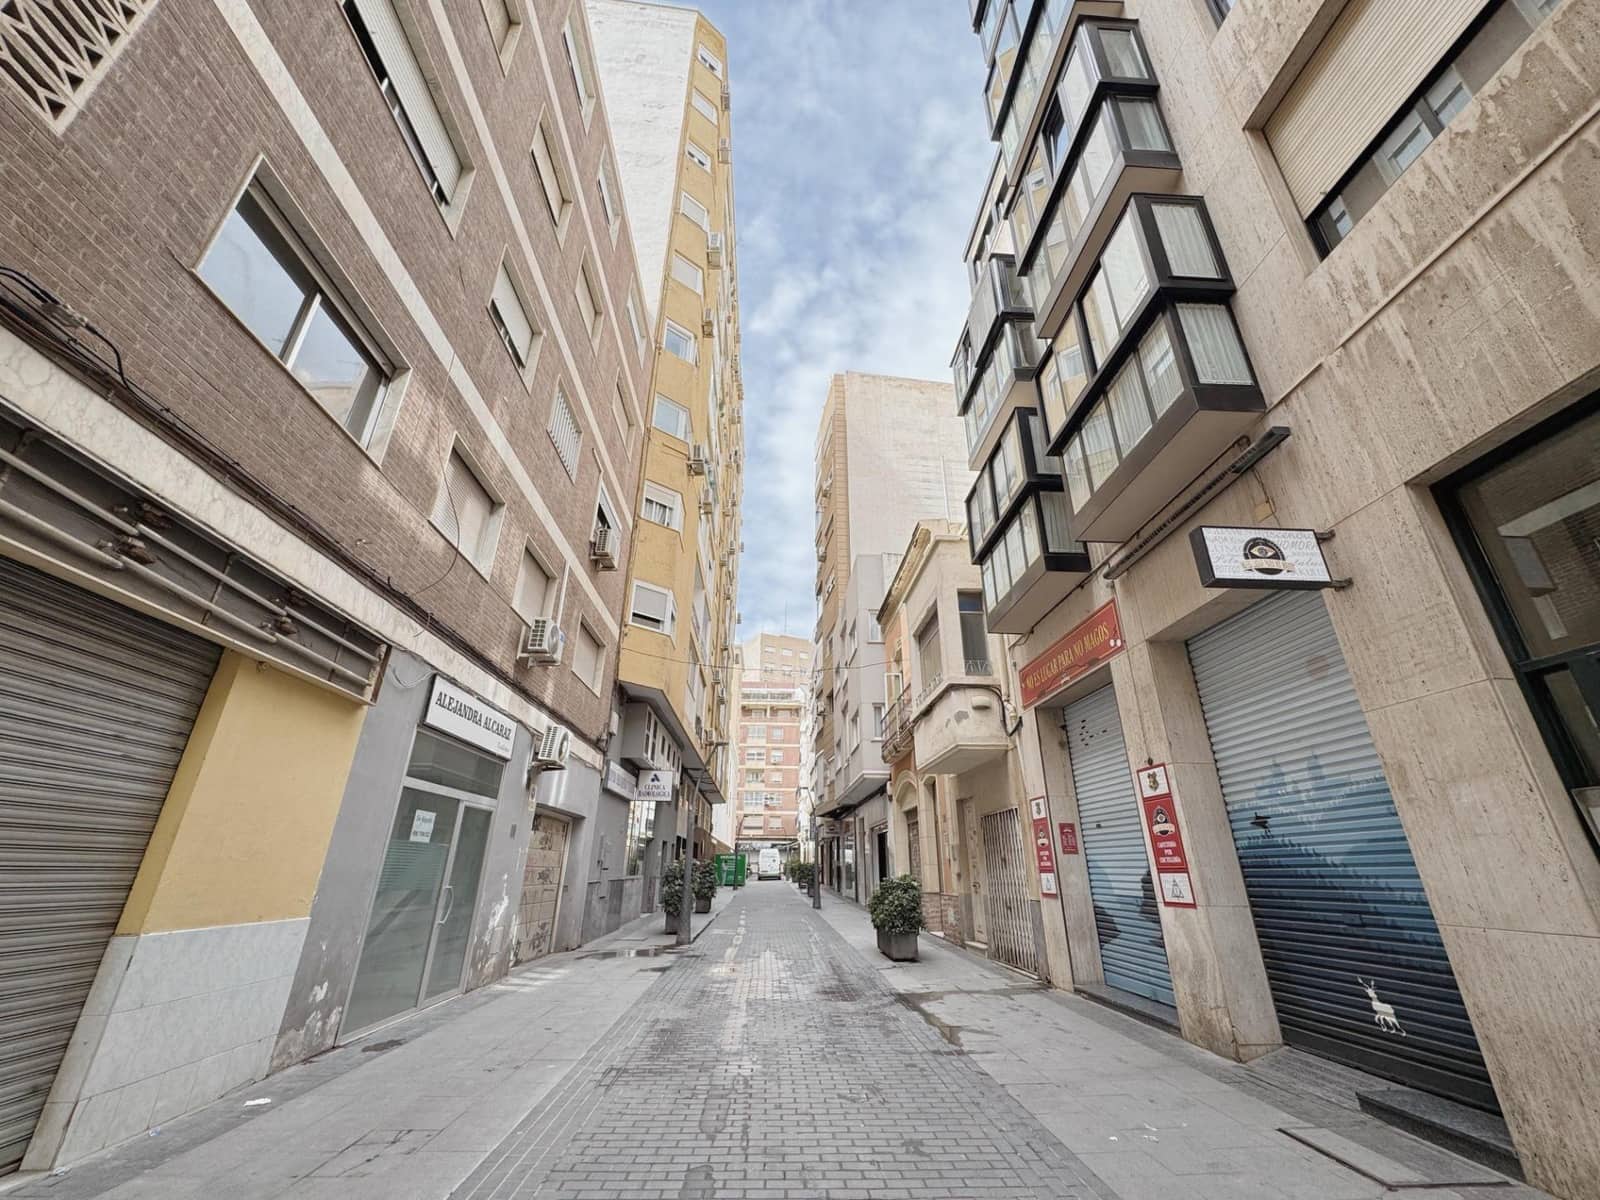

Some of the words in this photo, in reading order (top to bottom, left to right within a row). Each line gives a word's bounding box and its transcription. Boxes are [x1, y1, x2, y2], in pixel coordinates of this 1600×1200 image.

[1026, 674, 1034, 689] NO
[1033, 671, 1042, 686] ES
[1040, 658, 1058, 682] LUGAR
[1058, 647, 1074, 671] PARA
[1073, 640, 1085, 659] NO
[1084, 622, 1110, 653] MAGOS
[435, 691, 482, 727] ALEJANDRA
[483, 716, 512, 740] ALCARAZ
